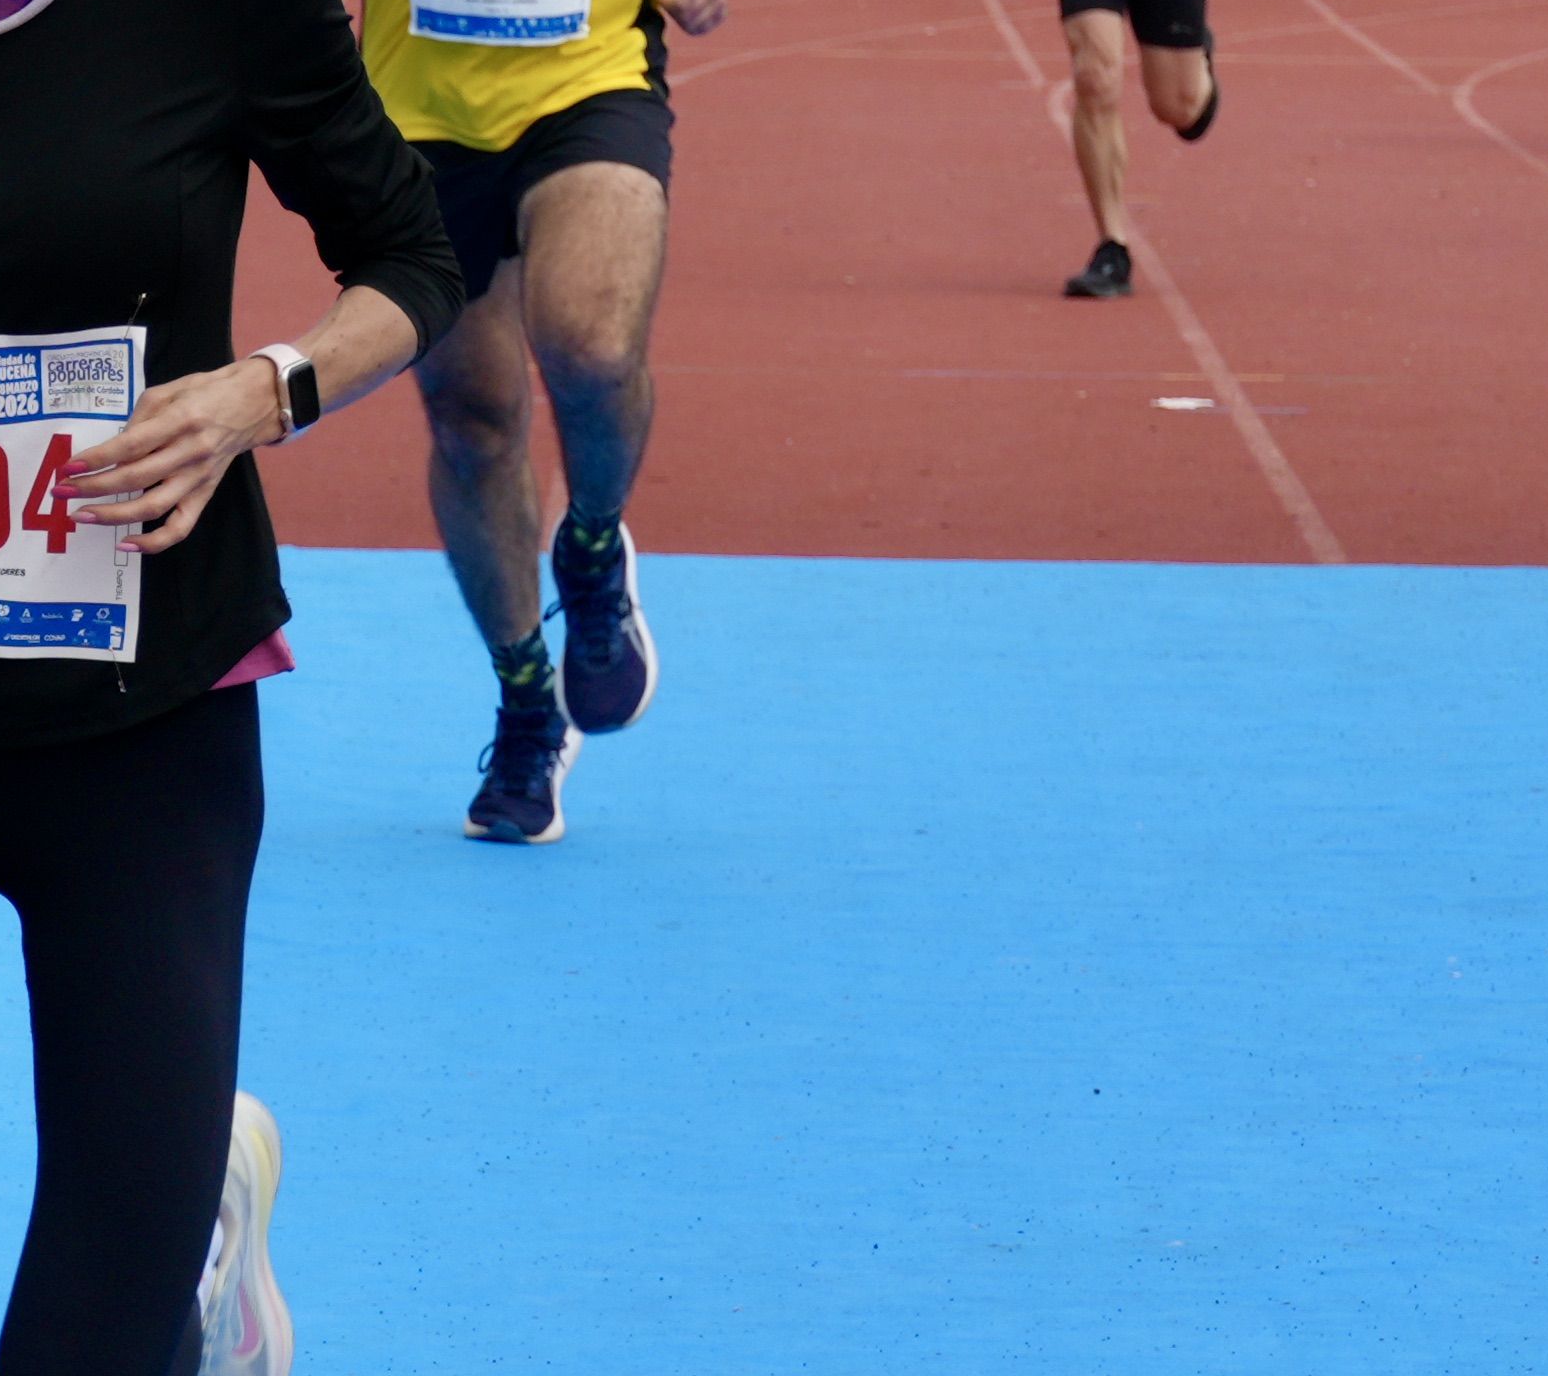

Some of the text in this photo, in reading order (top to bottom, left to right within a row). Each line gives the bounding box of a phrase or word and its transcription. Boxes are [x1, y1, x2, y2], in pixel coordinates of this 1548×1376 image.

[24, 352, 36, 364] de
[47, 356, 112, 372] carreras
[48, 366, 125, 387] populares
[48, 385, 125, 396] Diputación de Córdoba
